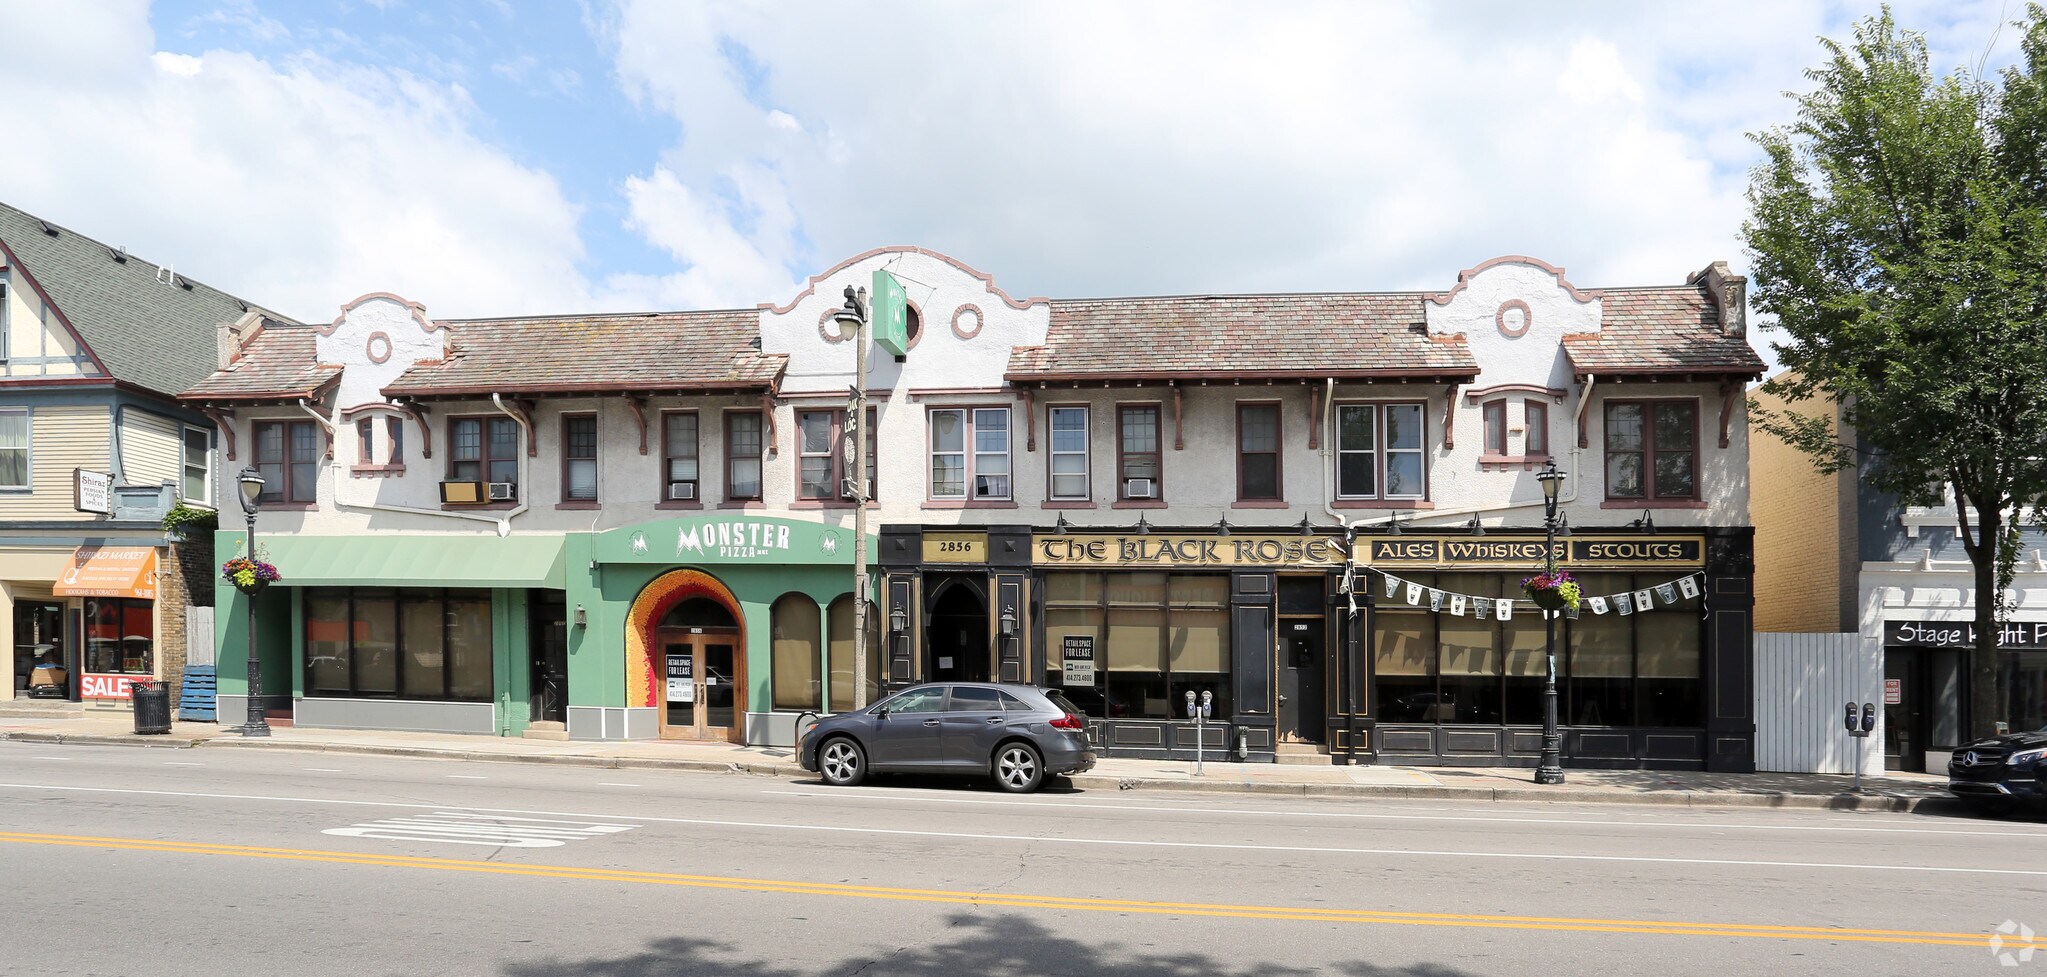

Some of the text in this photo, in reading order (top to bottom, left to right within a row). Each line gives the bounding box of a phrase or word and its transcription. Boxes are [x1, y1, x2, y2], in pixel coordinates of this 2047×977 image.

[676, 522, 790, 557] MONSTER
[940, 541, 972, 552] 2856
[110, 551, 146, 560] MARKET
[720, 547, 755, 558] PIZZA
[1117, 537, 1221, 561] BLACK
[1231, 538, 1330, 562] ROSE
[1377, 543, 1435, 558] ALES
[1588, 543, 1682, 558] STOUTS
[1897, 621, 1961, 646] Stage
[1065, 648, 1091, 657] FOR LEASE
[668, 667, 691, 675] FOR LEASE
[82, 676, 130, 697] SALE
